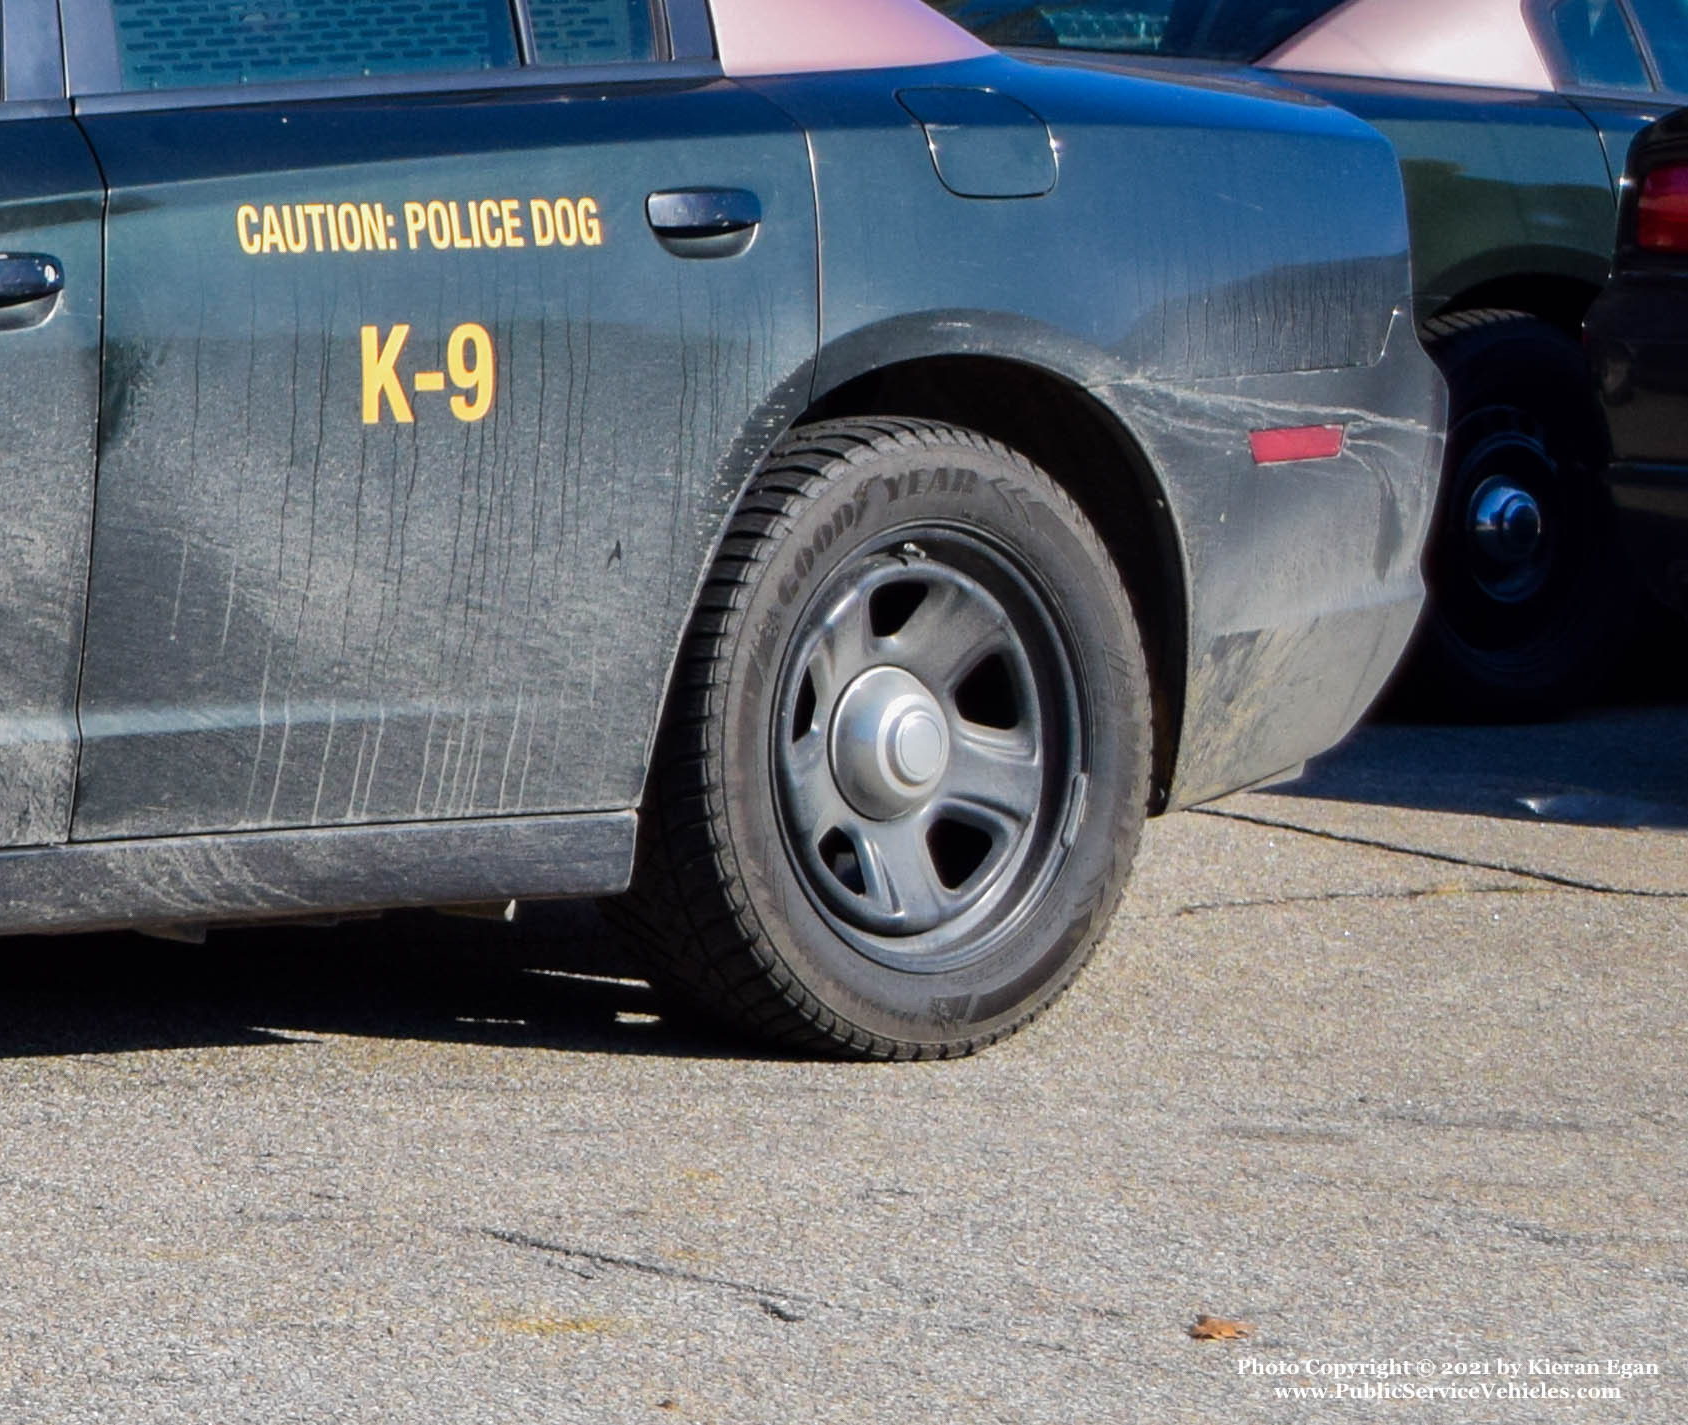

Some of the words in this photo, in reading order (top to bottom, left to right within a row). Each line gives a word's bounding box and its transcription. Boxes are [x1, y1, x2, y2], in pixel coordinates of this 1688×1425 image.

[236, 202, 398, 255] CAUTION:
[404, 199, 525, 251] POLICE
[531, 197, 603, 247] DOG
[360, 323, 496, 425] K-9
